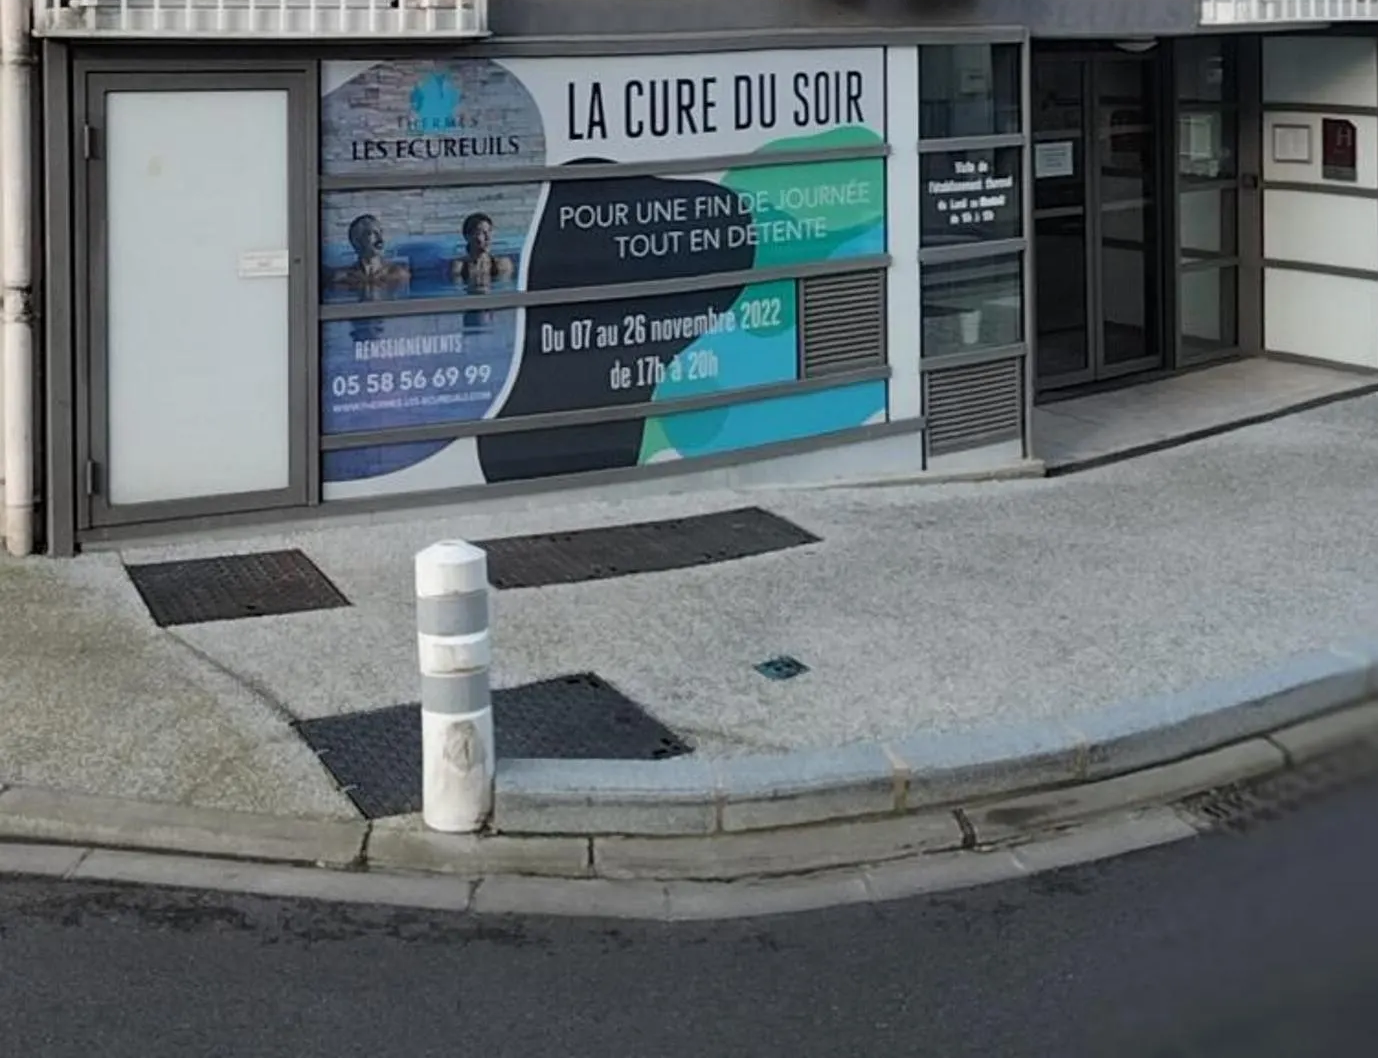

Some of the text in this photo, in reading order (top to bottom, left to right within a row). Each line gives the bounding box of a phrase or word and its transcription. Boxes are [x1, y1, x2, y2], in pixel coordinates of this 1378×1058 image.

[568, 70, 865, 140] LA CURE DU SOIR
[351, 135, 520, 160] LES ECUREUILS
[559, 180, 870, 229] POUR UNE FIN DE JOURNÉE
[614, 216, 827, 259] TOUT EN DÉTENTE
[541, 299, 781, 353] Du 07 au 26 novembre 2022
[332, 364, 492, 396] 05 58 56 69 99
[610, 351, 718, 389] de 17h à 20h
